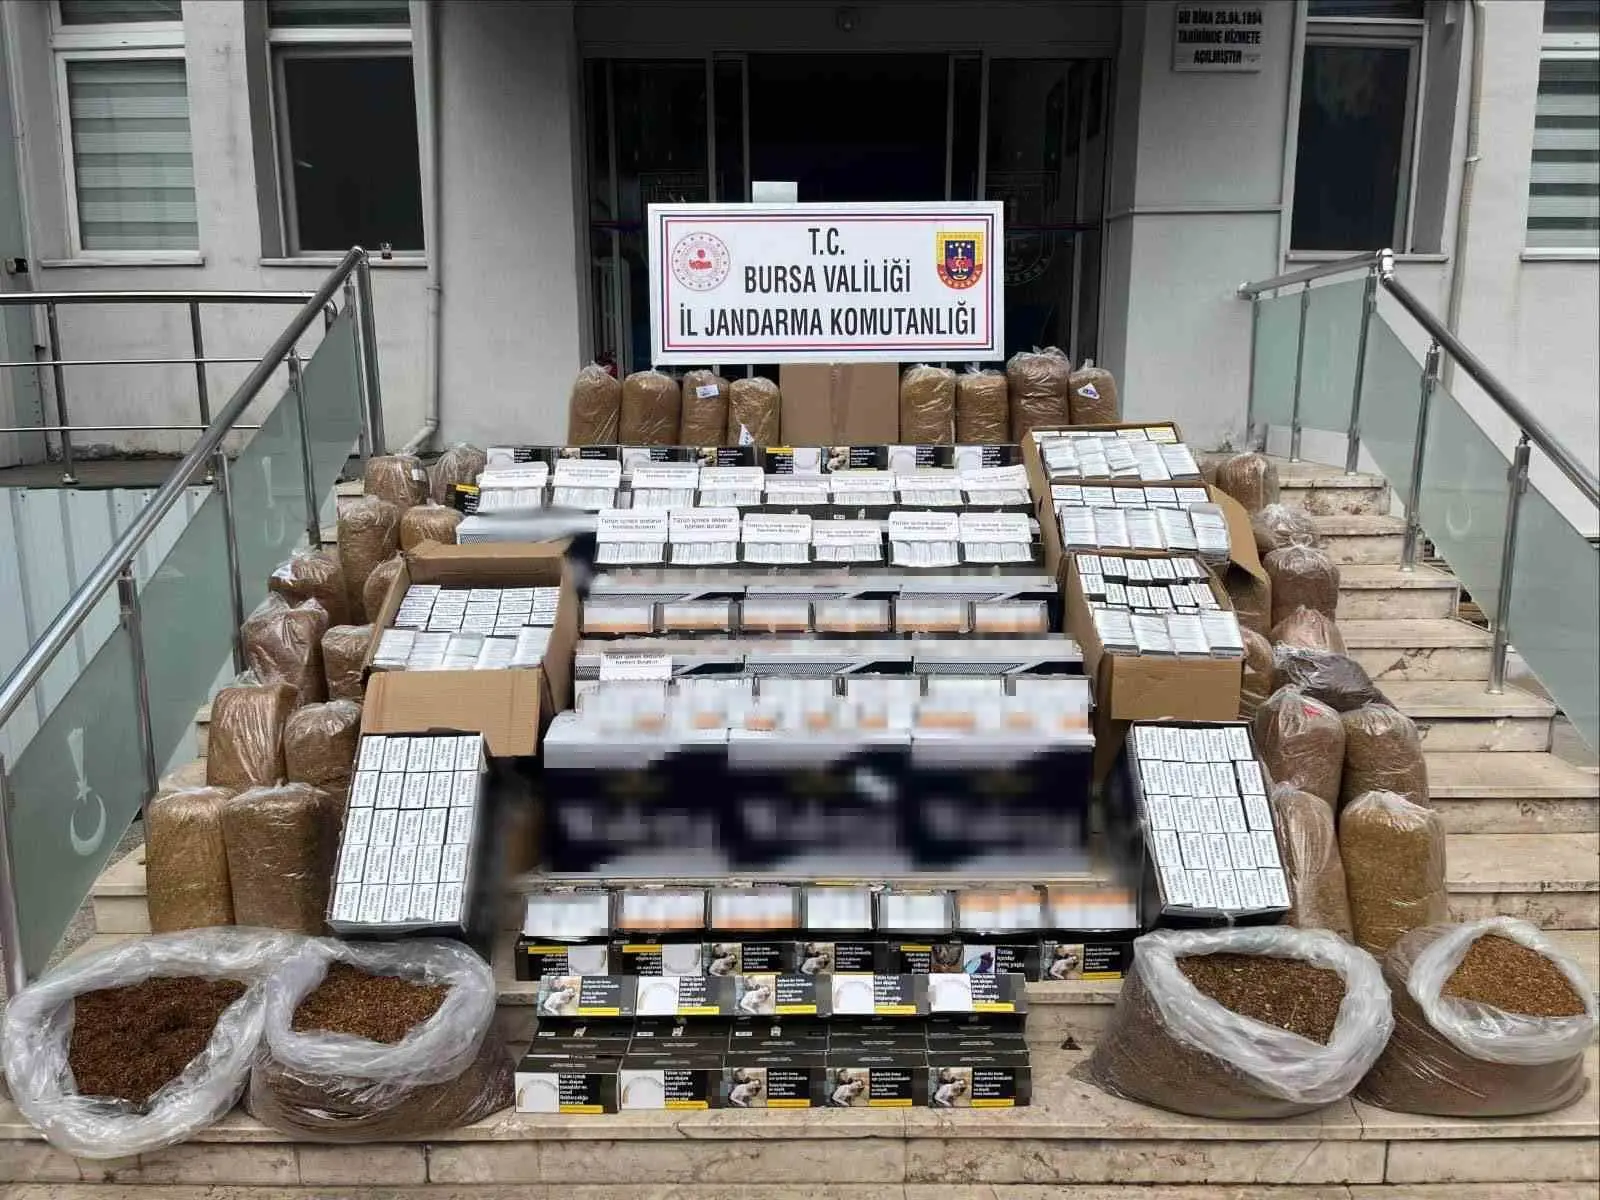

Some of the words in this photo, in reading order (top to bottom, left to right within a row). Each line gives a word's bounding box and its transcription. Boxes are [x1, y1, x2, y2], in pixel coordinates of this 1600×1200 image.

[807, 227, 846, 256] T.C.
[744, 264, 816, 294] BURSA
[823, 258, 911, 294] VALİLİĞİ
[679, 303, 698, 337] İL
[705, 307, 823, 337] JANDARMA
[830, 301, 977, 337] KOMUTANLIĞI
